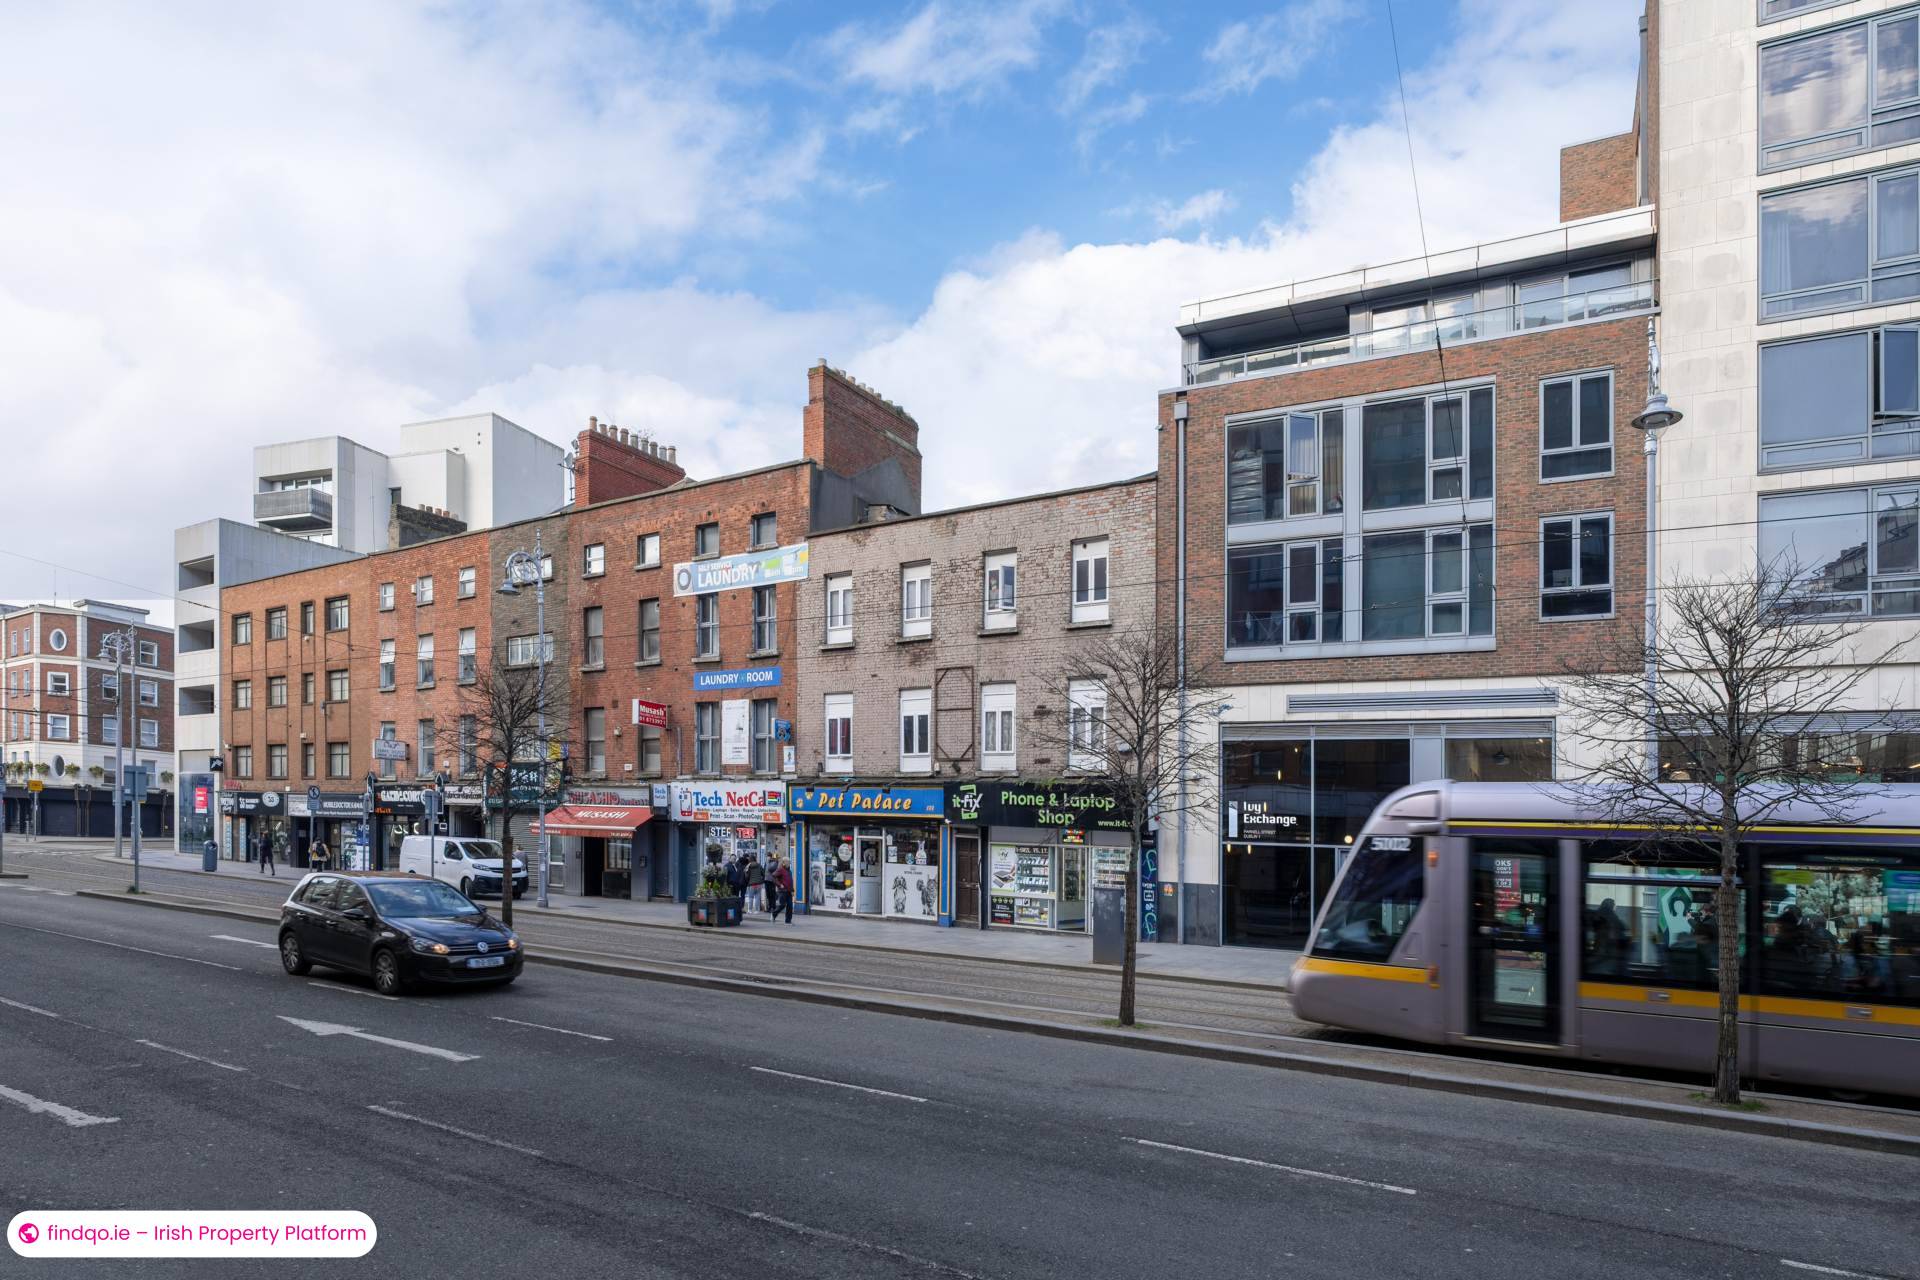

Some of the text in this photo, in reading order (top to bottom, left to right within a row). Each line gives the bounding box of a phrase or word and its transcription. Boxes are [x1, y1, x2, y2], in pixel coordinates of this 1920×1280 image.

[697, 563, 758, 587] LAUNDRY
[700, 671, 773, 685] LAUNDRY ROOM
[692, 790, 723, 806] Tech
[818, 792, 913, 810] Pet Palace
[952, 792, 984, 812] it-fix
[1001, 791, 1116, 811] Phone & Laptop
[574, 810, 631, 819] MUSASHI
[1243, 801, 1262, 814] Ivy
[1038, 810, 1075, 826] Shop
[1243, 813, 1297, 827] Exchange
